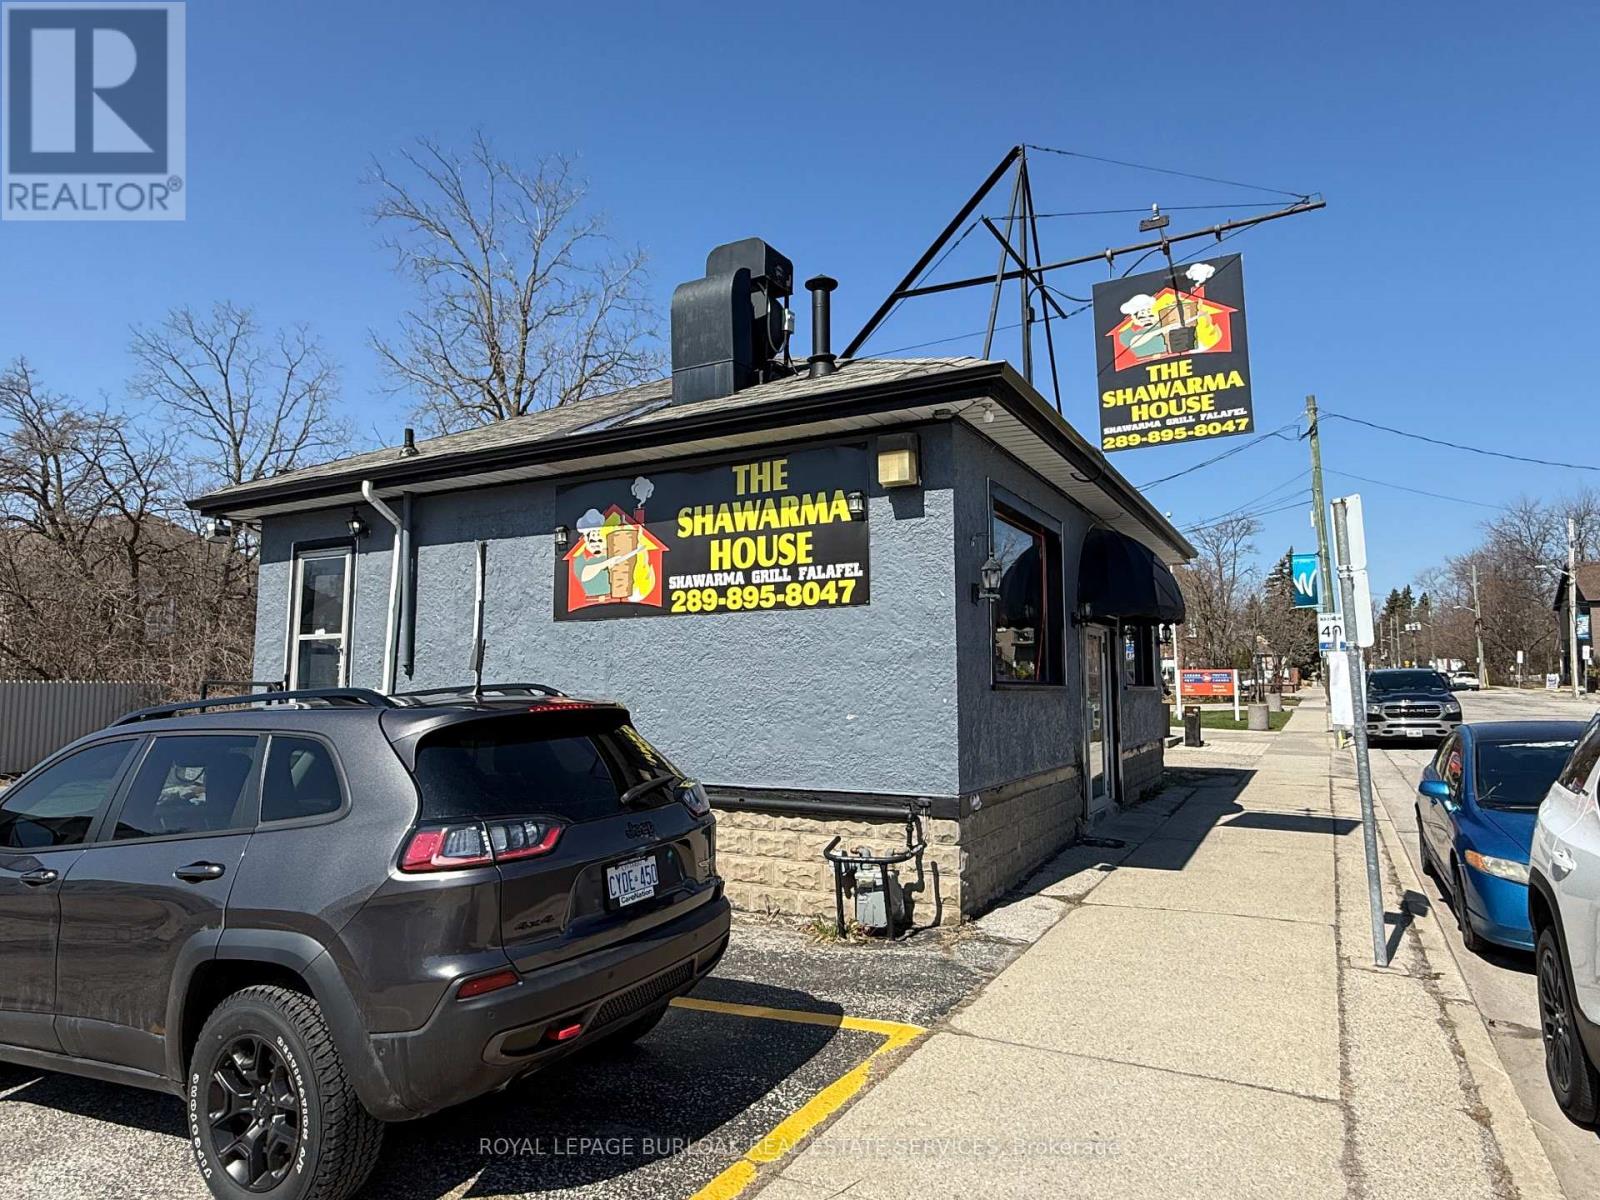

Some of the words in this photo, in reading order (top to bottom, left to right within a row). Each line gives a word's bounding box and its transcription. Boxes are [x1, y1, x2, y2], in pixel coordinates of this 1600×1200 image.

[1146, 359, 1193, 382] THE
[1102, 370, 1245, 408] SHAWARMA
[1104, 420, 1161, 435] SHAWARMA
[1166, 415, 1195, 426] GRILL
[1200, 408, 1247, 421] FALAFEL
[1131, 394, 1215, 422] HOUSE
[1103, 418, 1249, 450] 289-895-8047
[732, 459, 788, 495] THE
[677, 490, 852, 538] SHAWARMA
[710, 532, 814, 571] HOUSE
[669, 572, 744, 590] SHAWARMA
[751, 566, 791, 584] GRILL
[798, 562, 863, 580] FALAFEL
[670, 579, 856, 613] 289-895-8047
[609, 869, 636, 897] CYDE
[640, 863, 658, 887] 450
